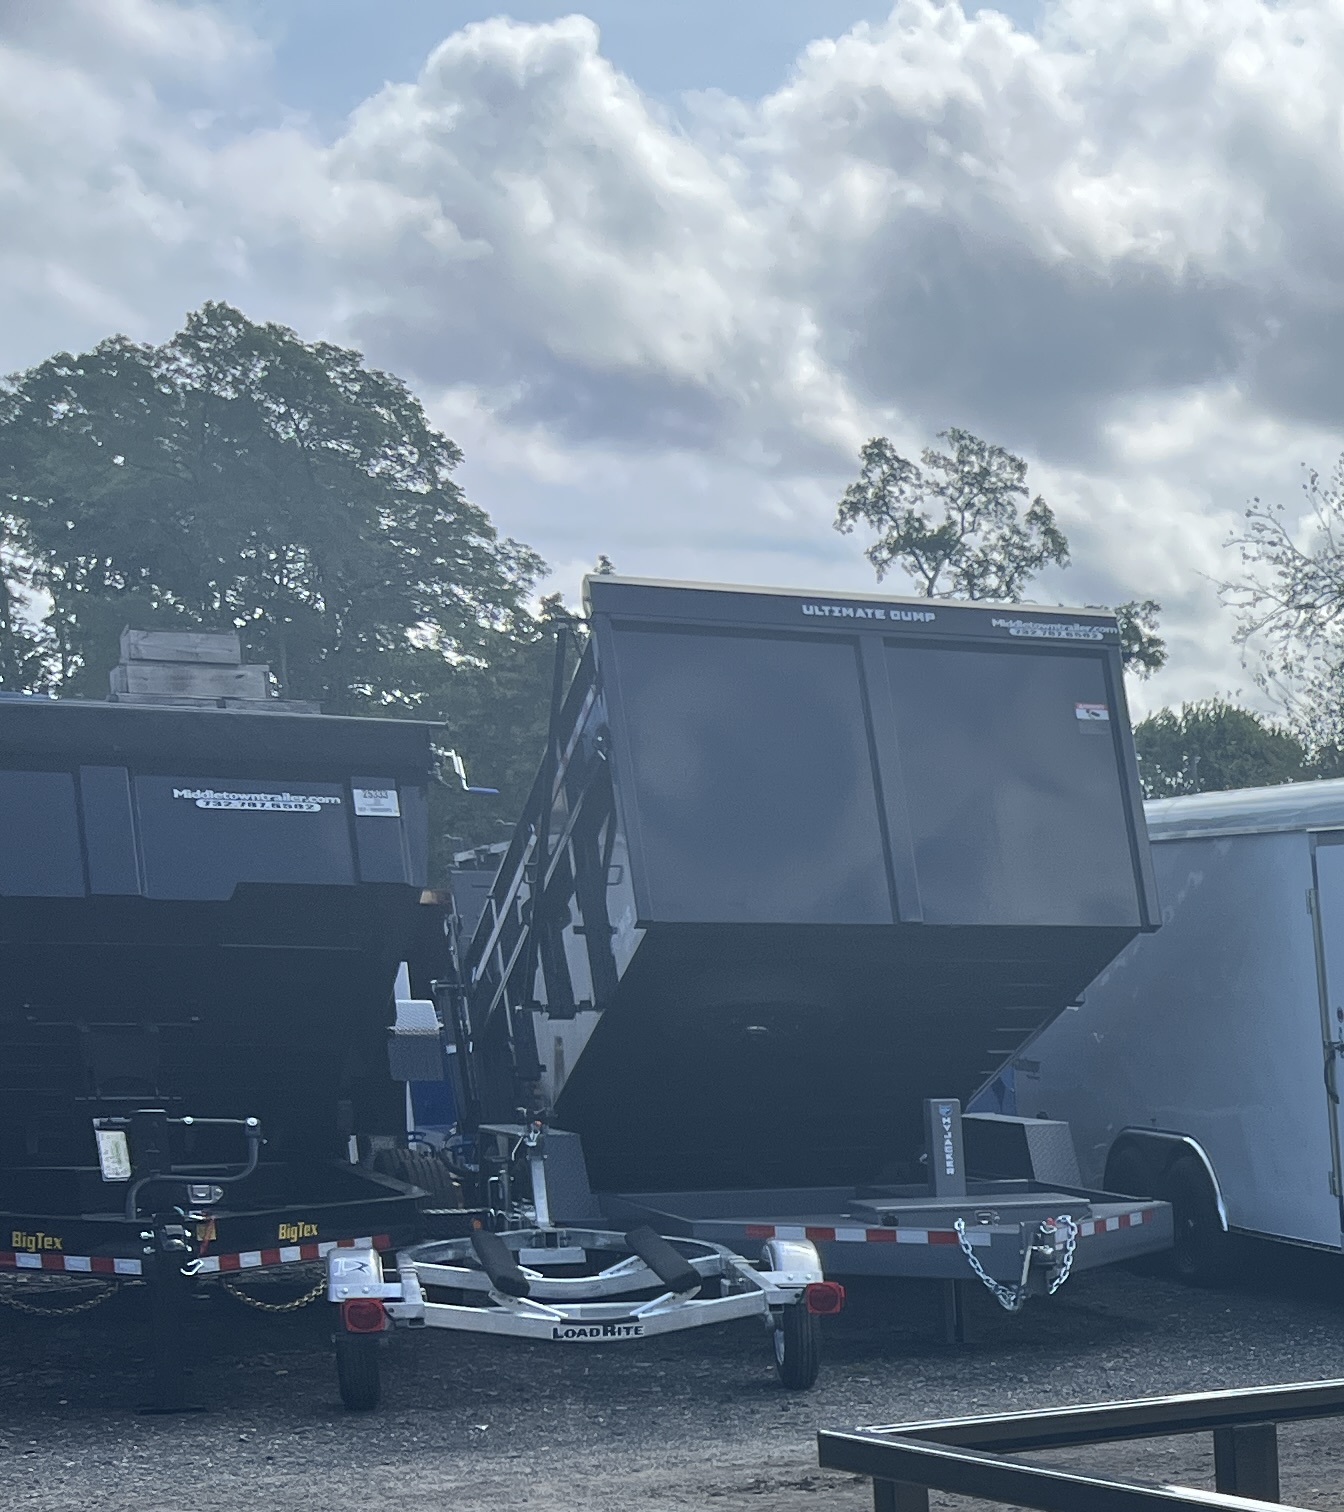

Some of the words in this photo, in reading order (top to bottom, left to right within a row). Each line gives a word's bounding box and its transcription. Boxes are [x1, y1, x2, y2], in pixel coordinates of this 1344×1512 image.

[802, 604, 886, 620] ULTIMATE
[890, 609, 936, 623] DUMP
[991, 617, 1118, 634] Middletowntrailer.com
[173, 788, 341, 804] Middletowntrailer.com
[942, 1116, 955, 1175] HYJACKER
[11, 1231, 63, 1252] BigTex
[278, 1221, 319, 1242] BigTex
